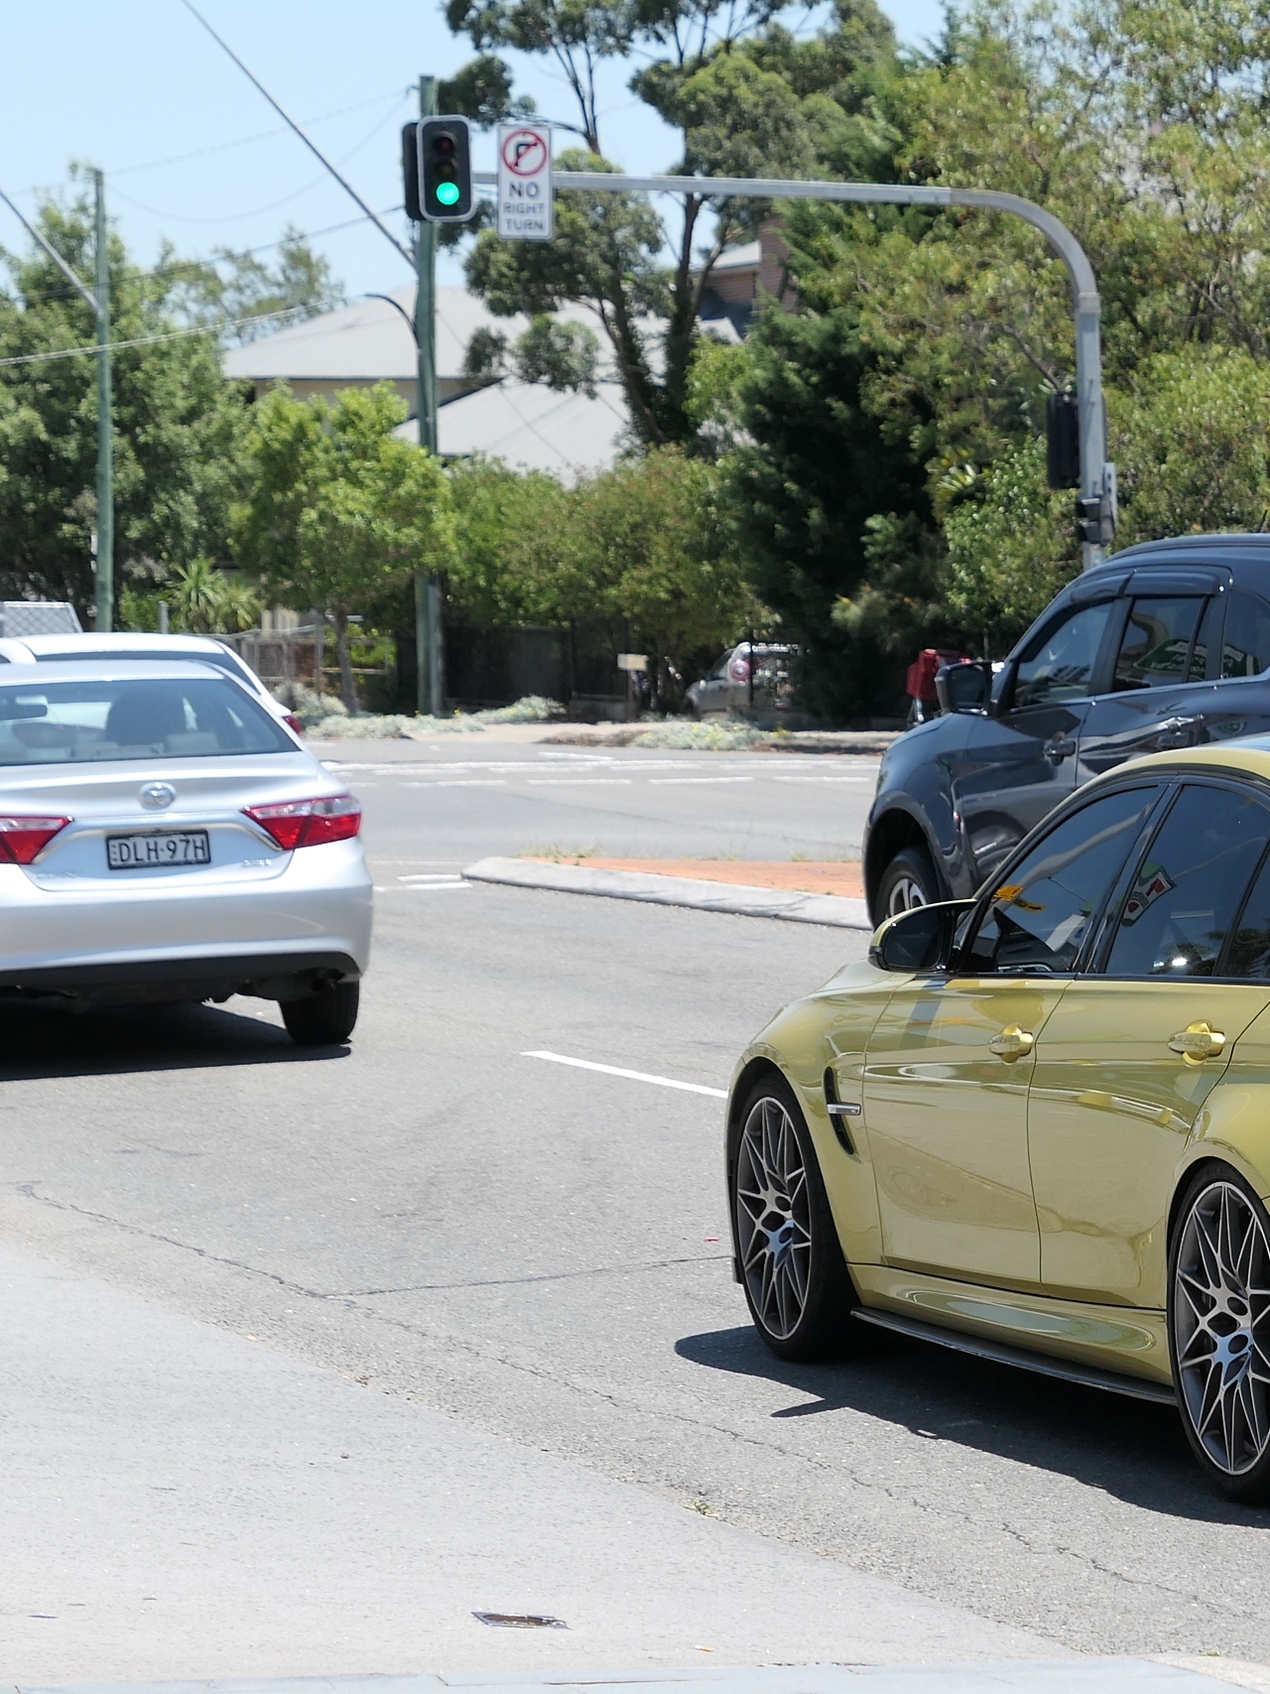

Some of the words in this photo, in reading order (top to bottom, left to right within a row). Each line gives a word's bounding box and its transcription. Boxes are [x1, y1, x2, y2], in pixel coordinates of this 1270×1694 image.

[509, 181, 539, 198] NO
[503, 202, 545, 214] RIGHT
[505, 218, 544, 230] TURN
